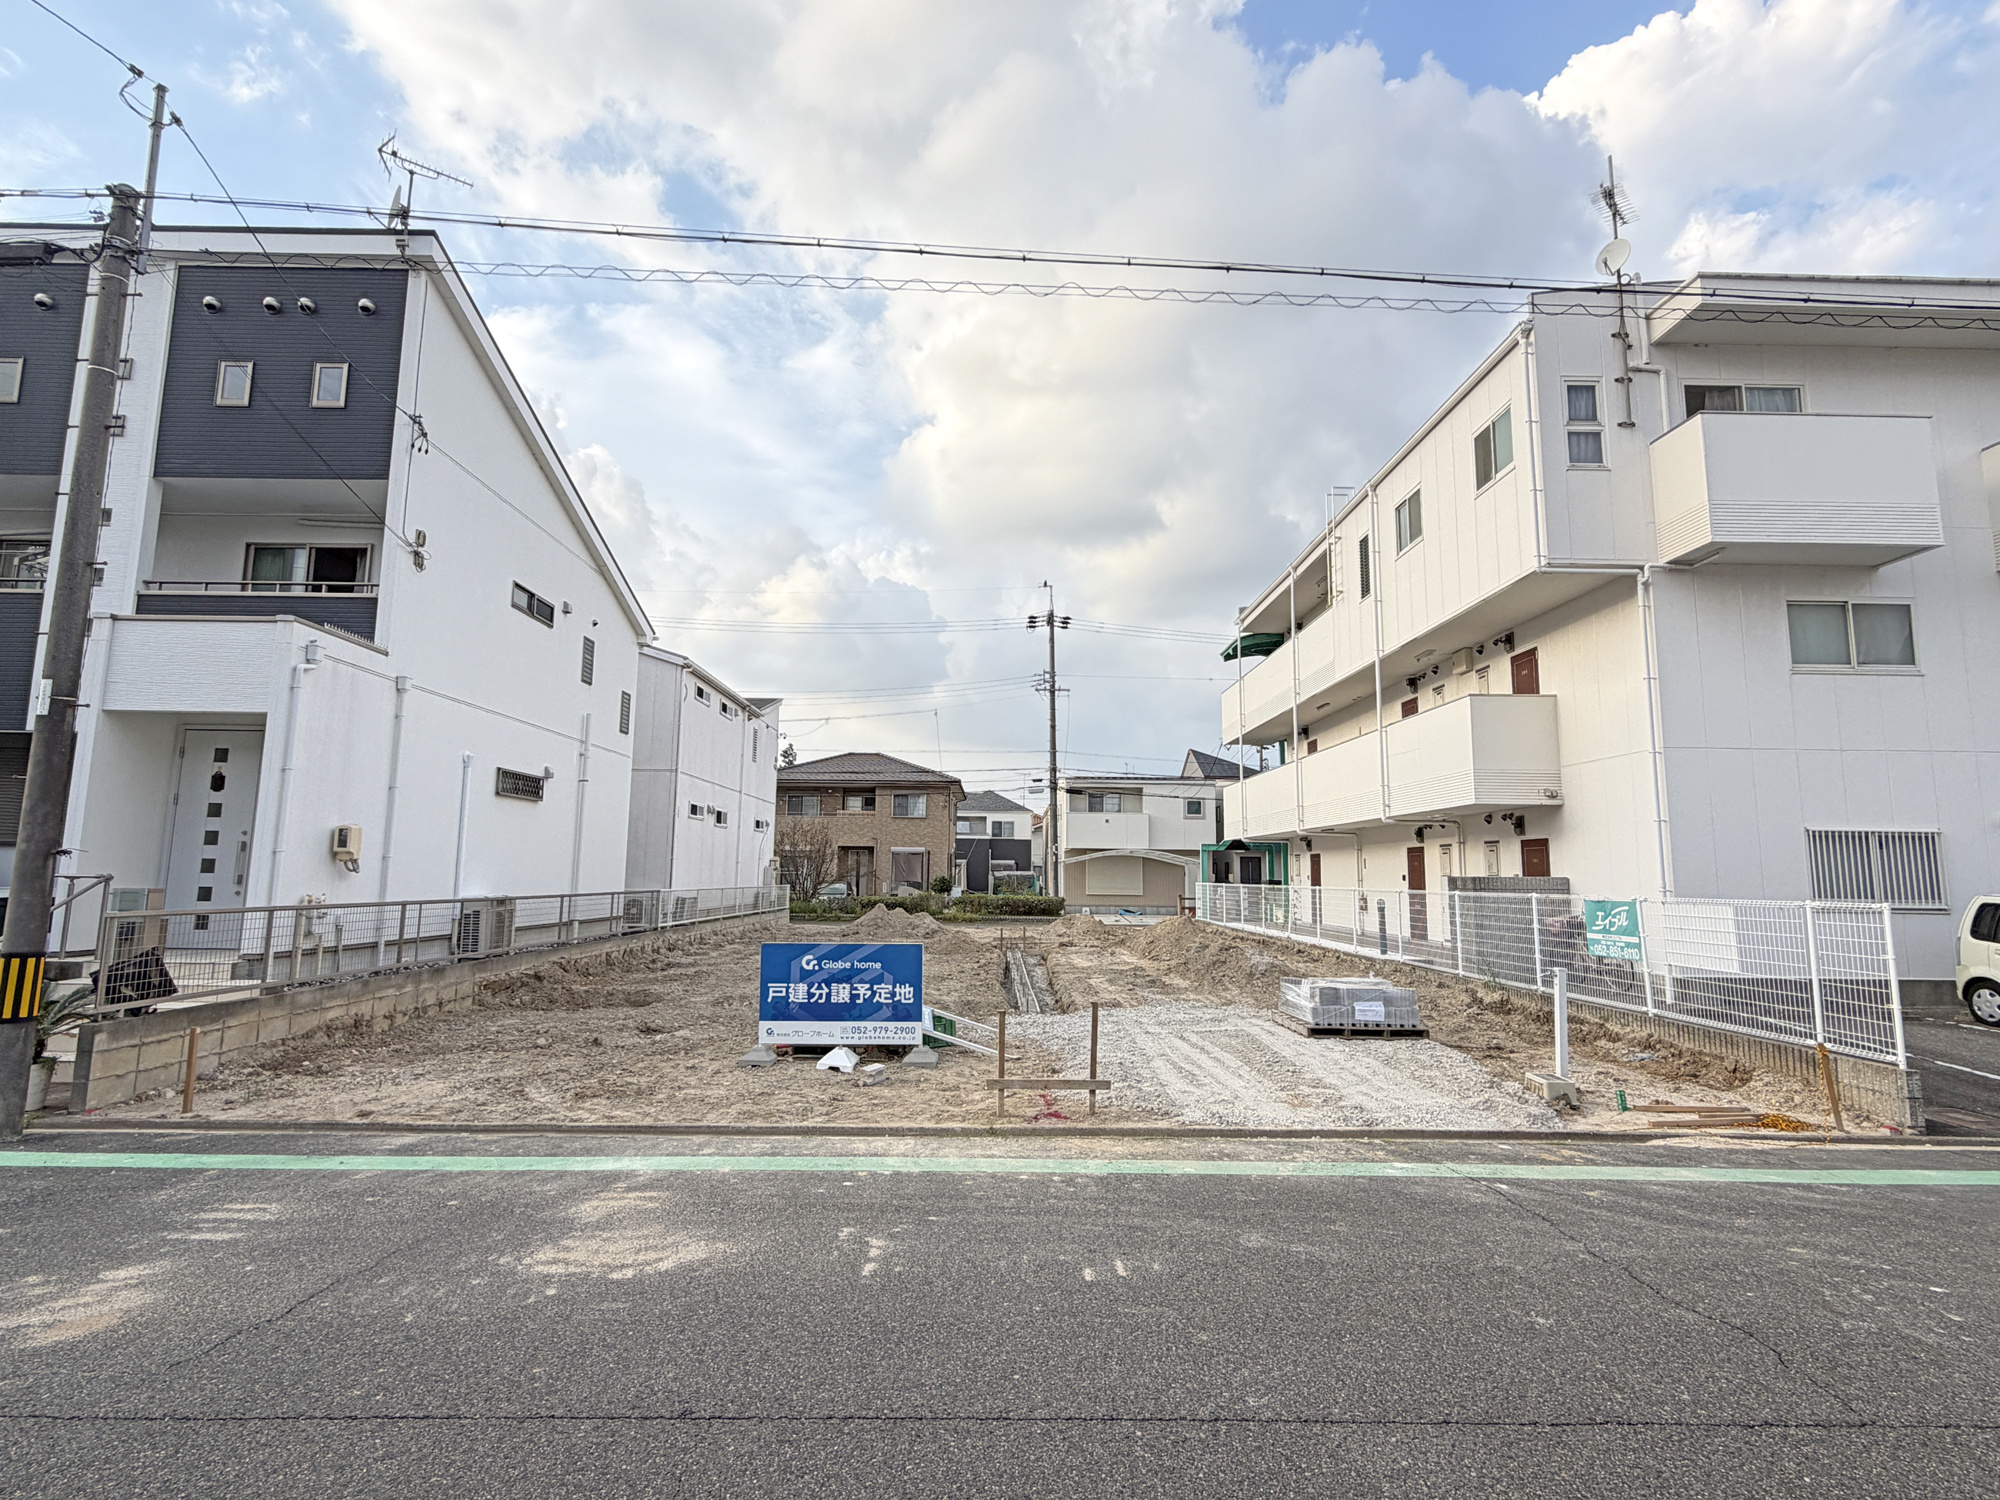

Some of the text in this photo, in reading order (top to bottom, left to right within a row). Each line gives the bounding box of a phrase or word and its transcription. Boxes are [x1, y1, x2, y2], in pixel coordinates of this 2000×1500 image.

[1591, 906, 1629, 931] エイブル
[821, 960, 851, 969] Globe
[854, 960, 882, 969] home
[767, 983, 914, 1004] 戸建分譲予定地
[851, 1026, 916, 1035] 052-979-2900
